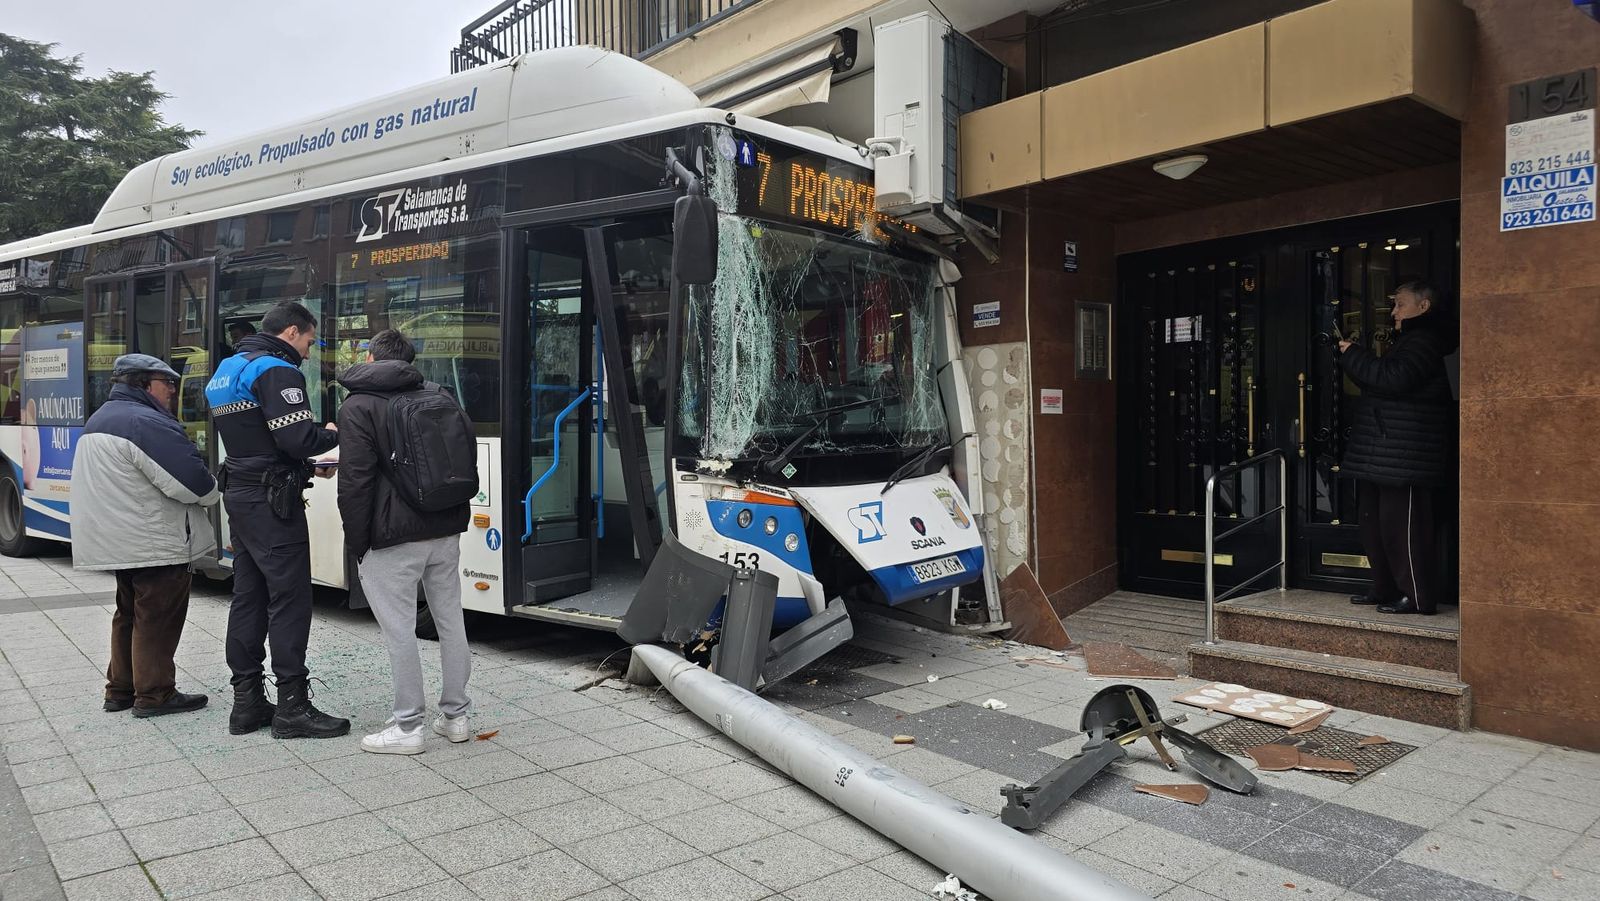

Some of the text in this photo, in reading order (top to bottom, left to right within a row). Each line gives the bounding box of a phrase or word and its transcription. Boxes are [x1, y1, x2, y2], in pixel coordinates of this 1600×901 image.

[1520, 73, 1589, 119] 154
[171, 87, 479, 187] Soy ecológico. Propulsado con gas natural
[1510, 160, 1533, 175] 923
[1538, 155, 1561, 171] 215
[1566, 150, 1591, 165] 444
[757, 152, 772, 207] 7
[1506, 168, 1591, 195] ALQUILA
[404, 178, 467, 211] Salamanca de
[394, 203, 469, 234] Transportes s.a.
[1505, 204, 1592, 228] 923 261 646
[351, 240, 449, 269] 7 PROSPERIDAD
[977, 311, 997, 320] VENDE
[38, 392, 83, 420] ANÚNCIATE
[51, 421, 70, 451] AQUÍ
[847, 500, 887, 544] ST
[911, 536, 946, 550] SCANIA
[719, 551, 760, 570] 153
[914, 562, 942, 580] 8823
